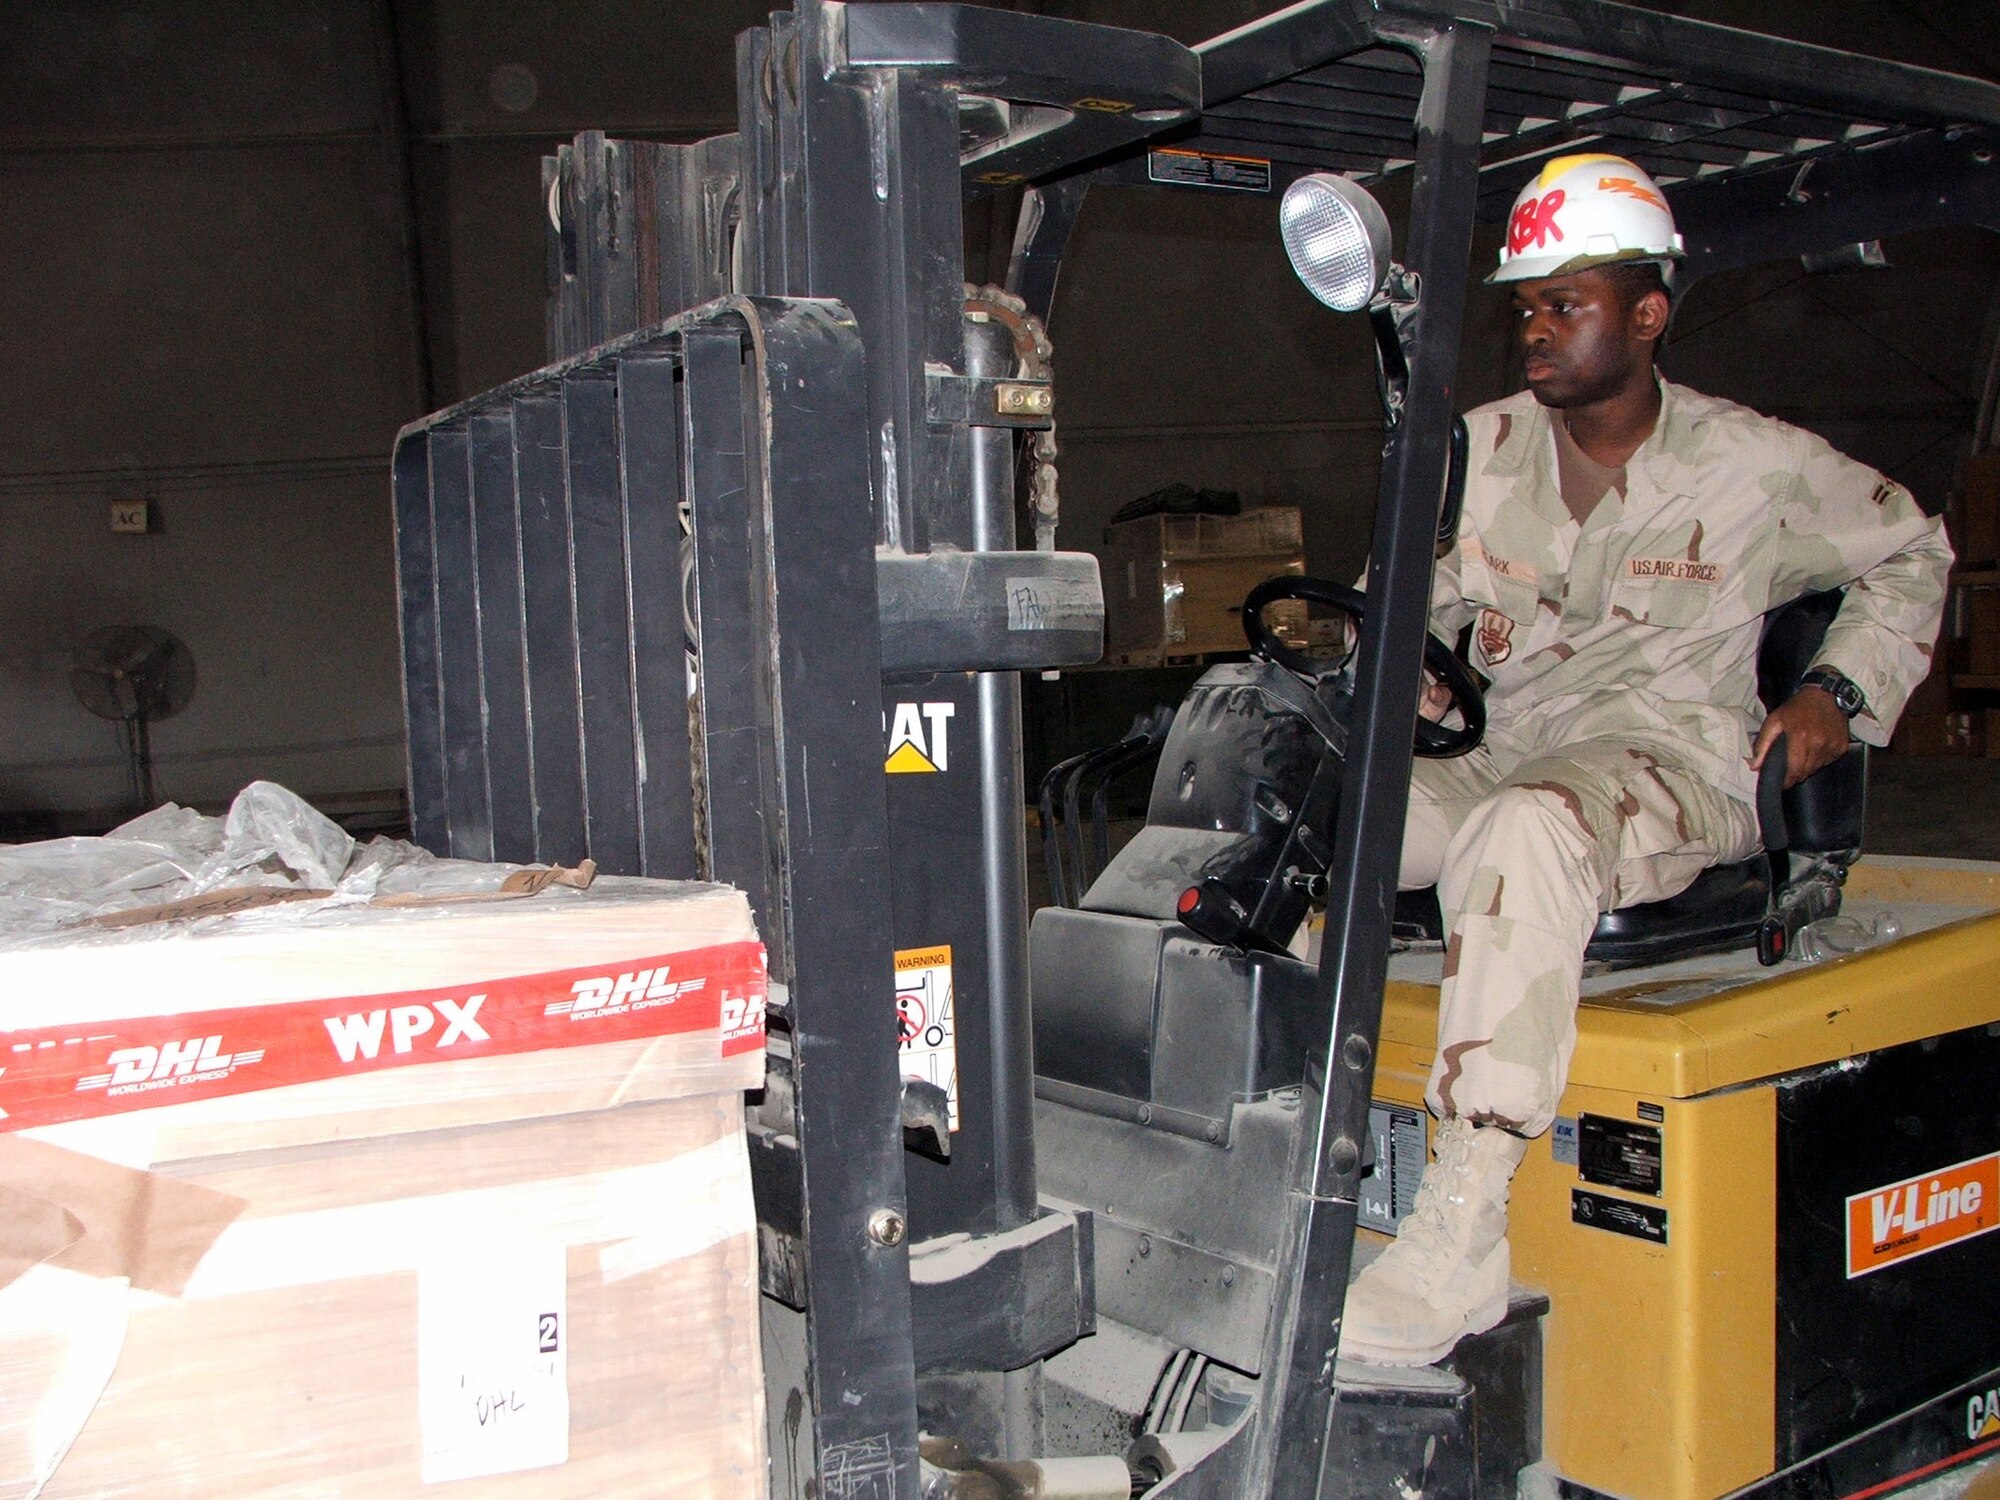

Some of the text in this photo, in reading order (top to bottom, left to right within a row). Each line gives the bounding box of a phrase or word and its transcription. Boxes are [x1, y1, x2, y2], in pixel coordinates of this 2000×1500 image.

[1508, 189, 1566, 258] KBR
[1652, 560, 1676, 577] AIR
[1678, 562, 1717, 581] FORCE
[882, 702, 955, 772] AT
[896, 953, 945, 969] WARNING
[570, 966, 679, 1011] DHL
[322, 993, 491, 1063] WPX
[569, 1004, 630, 1022] WORLDWIDE
[106, 1034, 234, 1084] DHL
[107, 1076, 177, 1097] WORLDWIDE
[1871, 1179, 1983, 1245] V-Line
[539, 1314, 558, 1351] 2
[1966, 1387, 2000, 1440] CA
